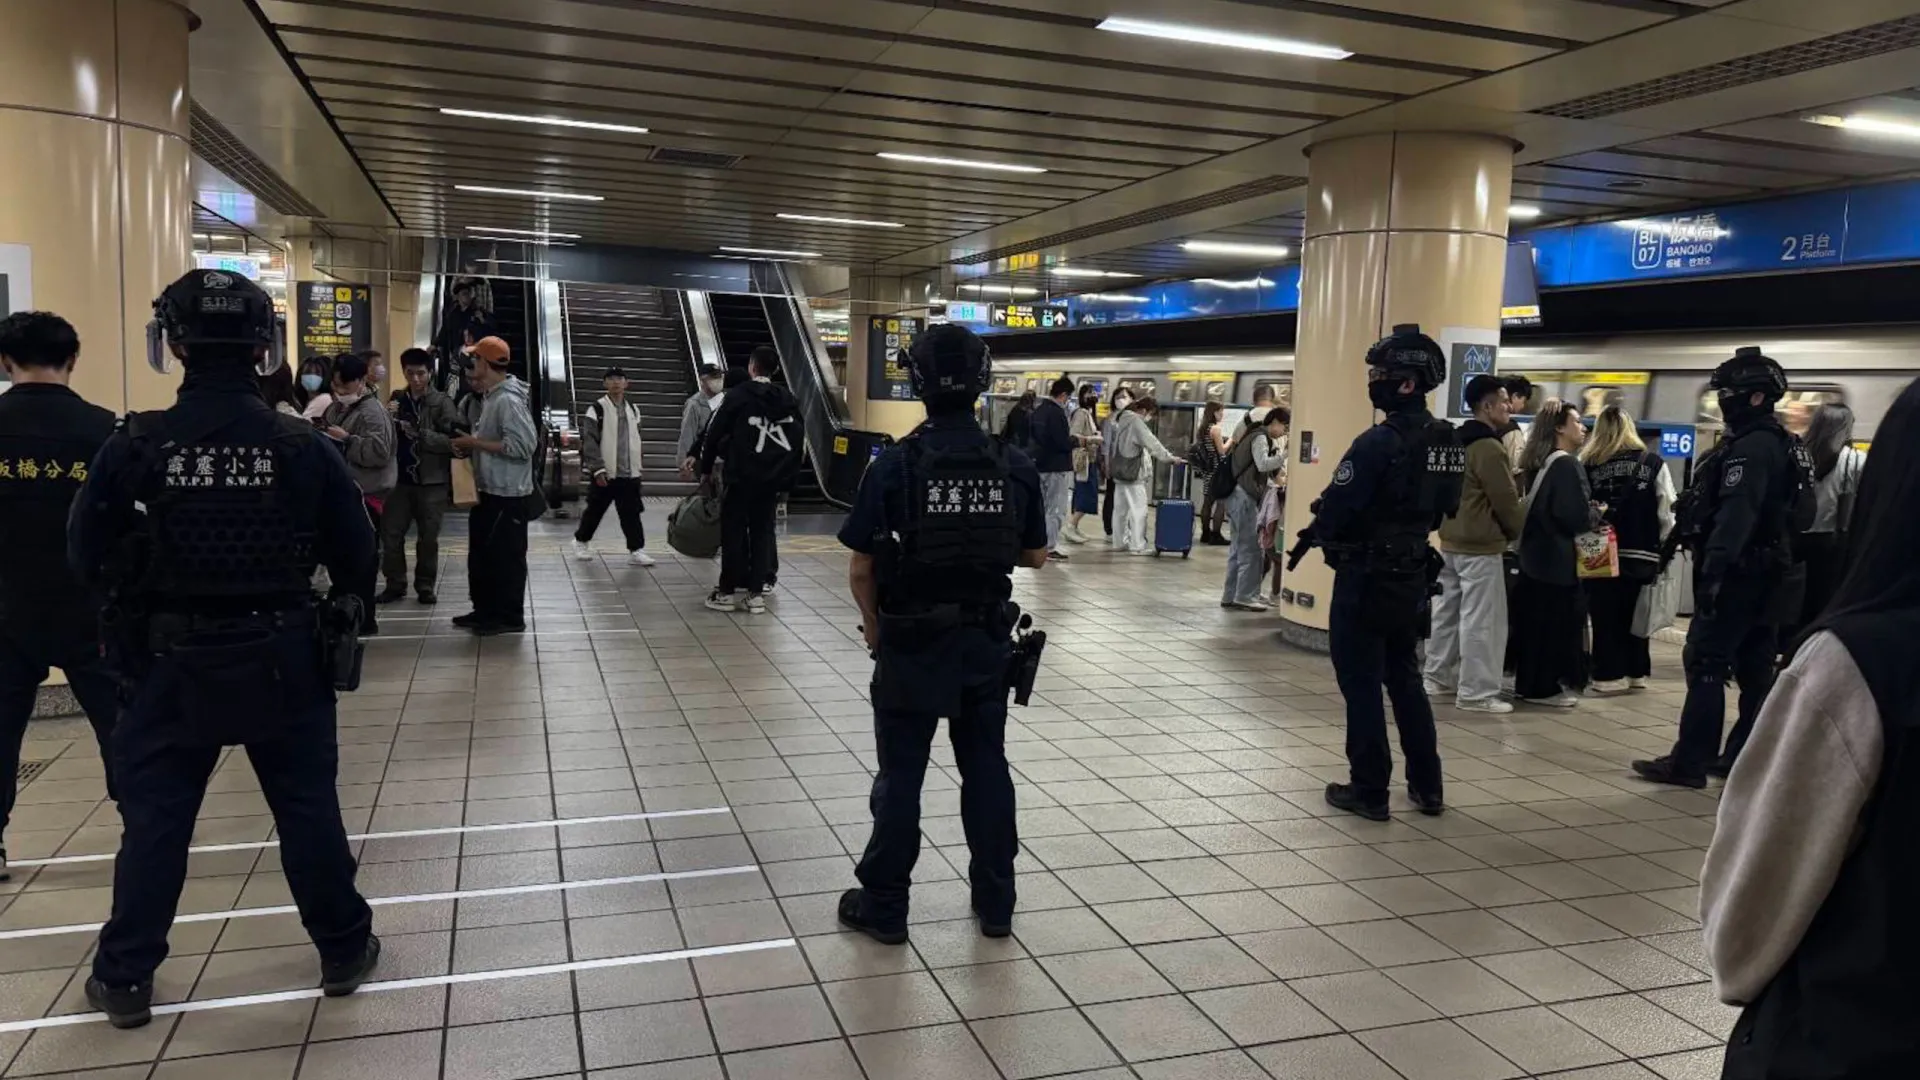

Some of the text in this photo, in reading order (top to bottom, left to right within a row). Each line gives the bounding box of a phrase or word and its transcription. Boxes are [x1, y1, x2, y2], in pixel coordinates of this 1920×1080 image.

[1638, 230, 1659, 246] BL
[1800, 232, 1831, 250] 月台
[1638, 247, 1657, 262] 07
[1666, 243, 1714, 258] BANQIAO
[1780, 236, 1797, 261] 2
[1799, 249, 1836, 260] Platform
[1679, 434, 1692, 453] 6
[165, 476, 275, 487] N.T.P.D S.W.A.T
[927, 504, 963, 513] N.T.P.D
